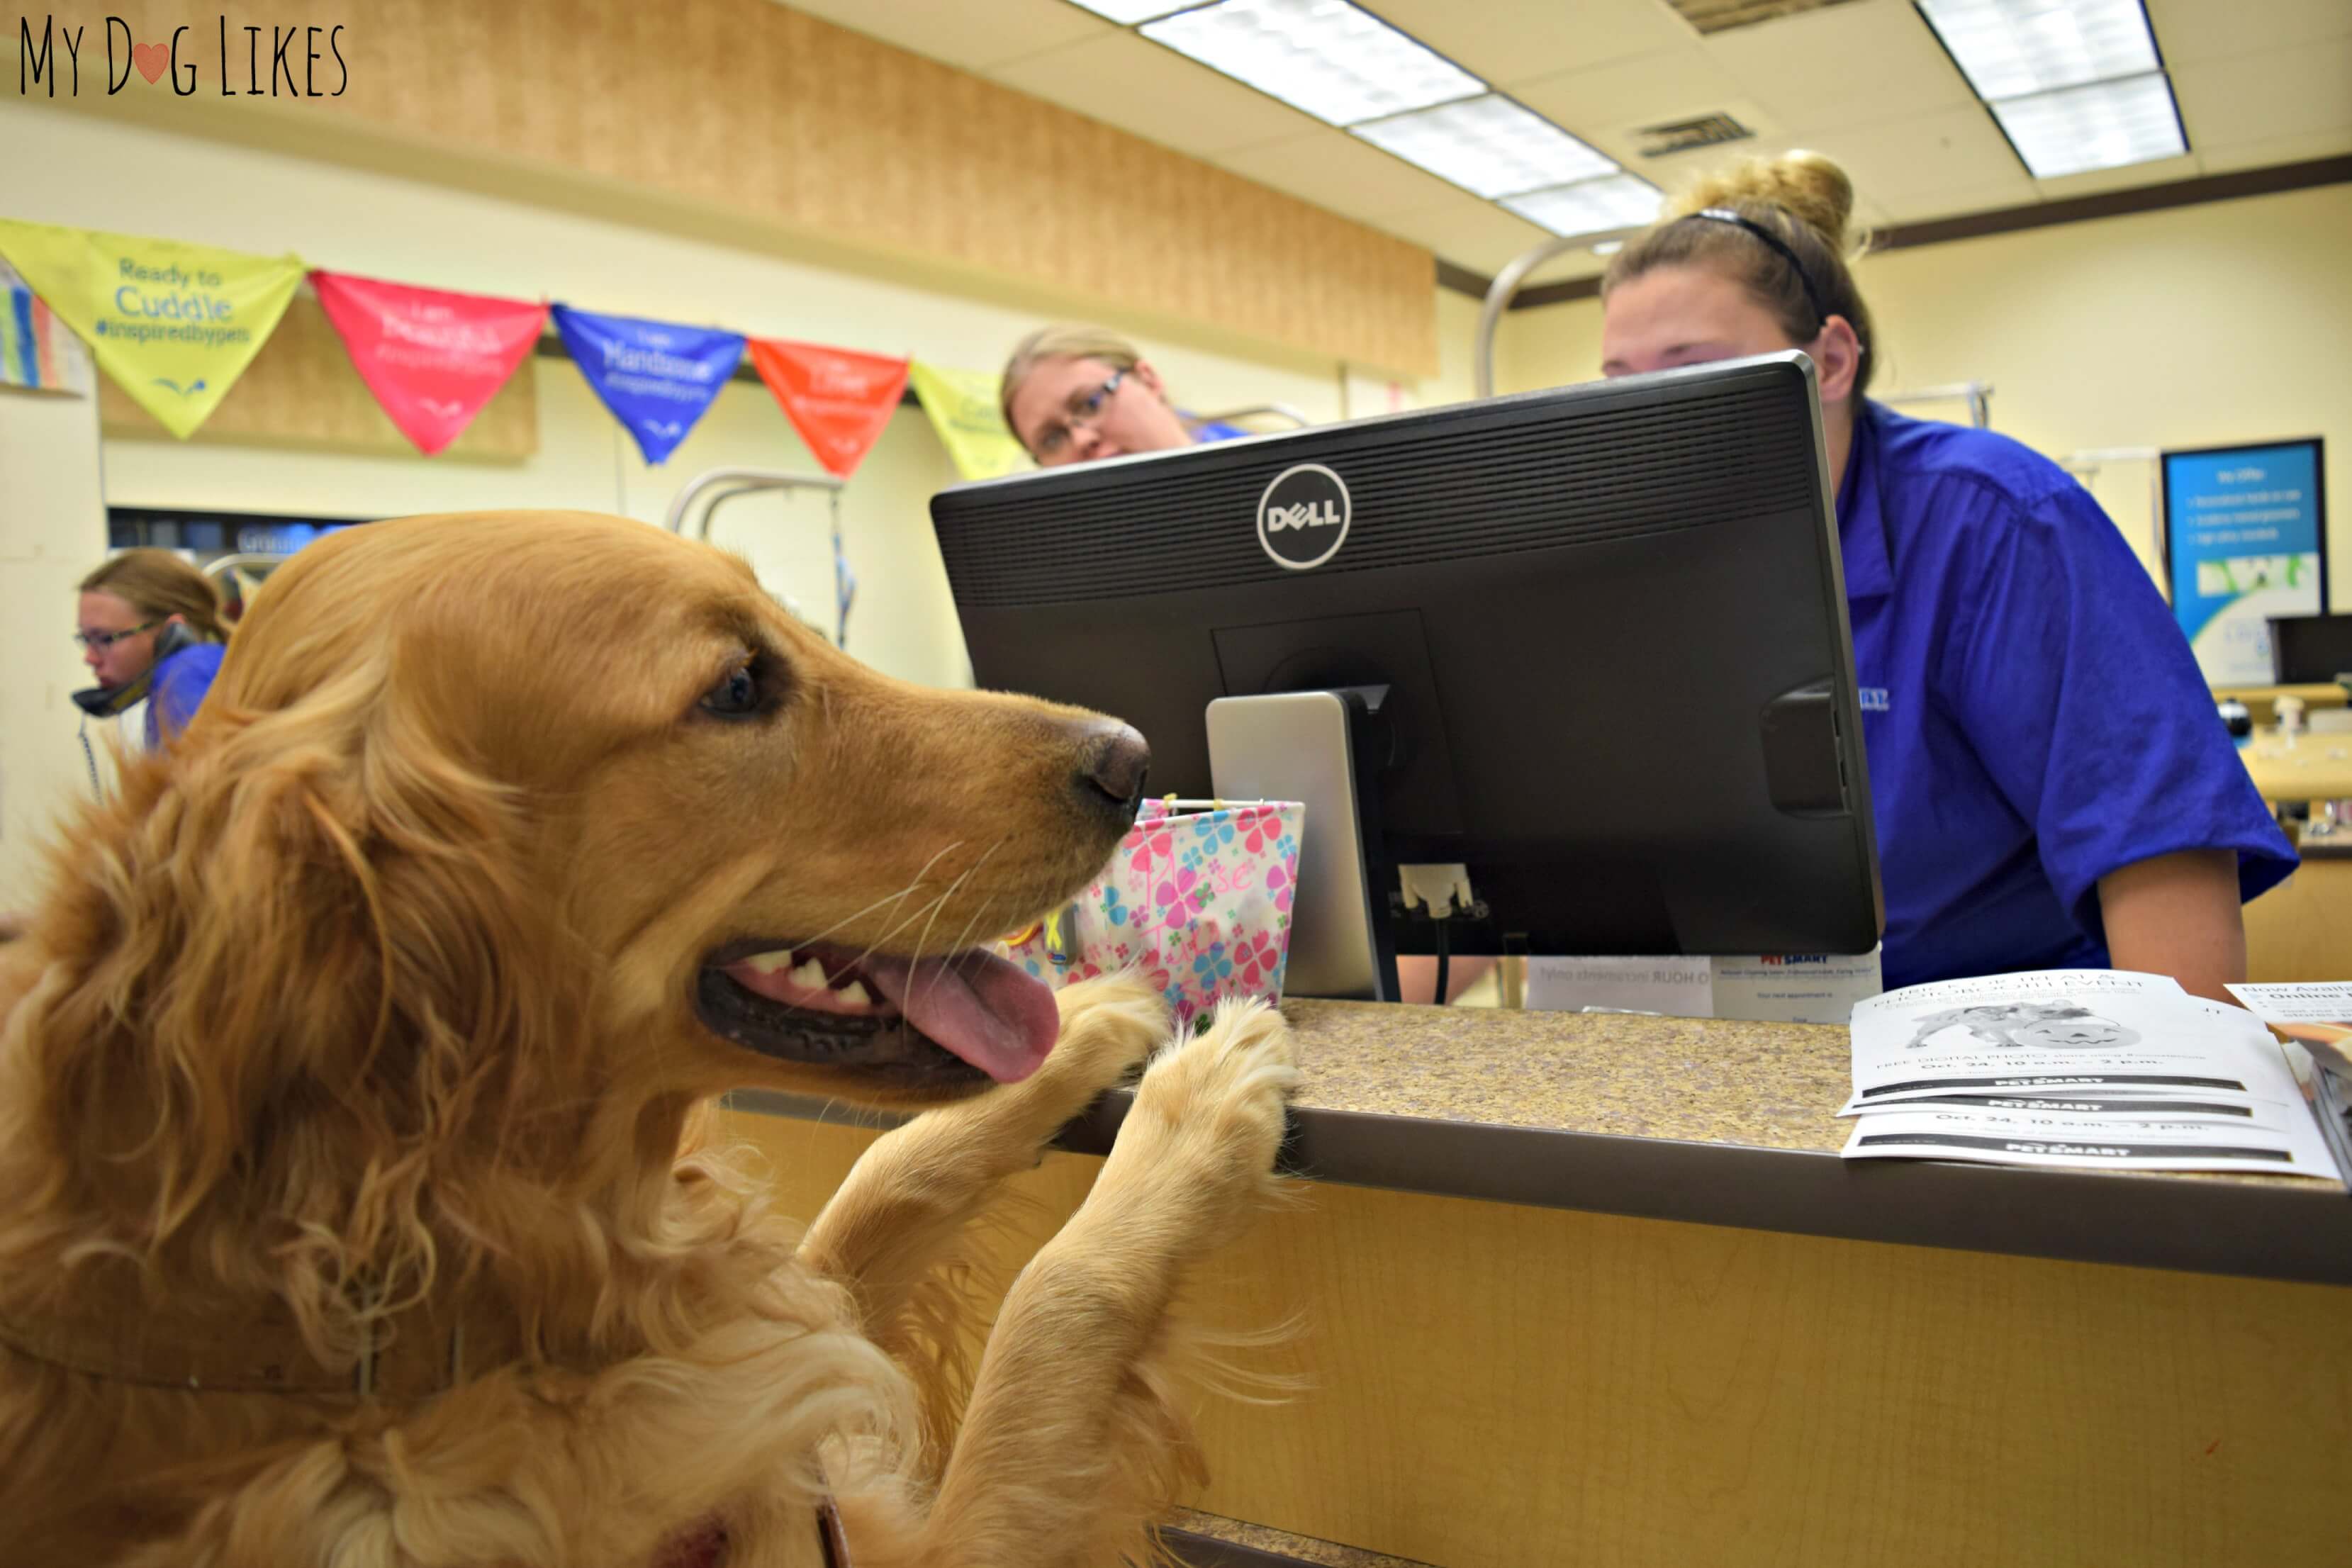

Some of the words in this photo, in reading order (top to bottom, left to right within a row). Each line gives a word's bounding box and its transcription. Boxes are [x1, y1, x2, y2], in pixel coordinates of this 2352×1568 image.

[118, 257, 189, 288] Ready
[196, 270, 222, 286] to
[114, 285, 234, 322] Cuddle
[1267, 500, 1341, 532] DELL
[2063, 979, 2146, 987] EVENT
[1994, 1076, 2105, 1086] PETSMART
[1987, 1099, 2103, 1111] PETSMART
[2005, 1141, 2130, 1157] PETSMART
